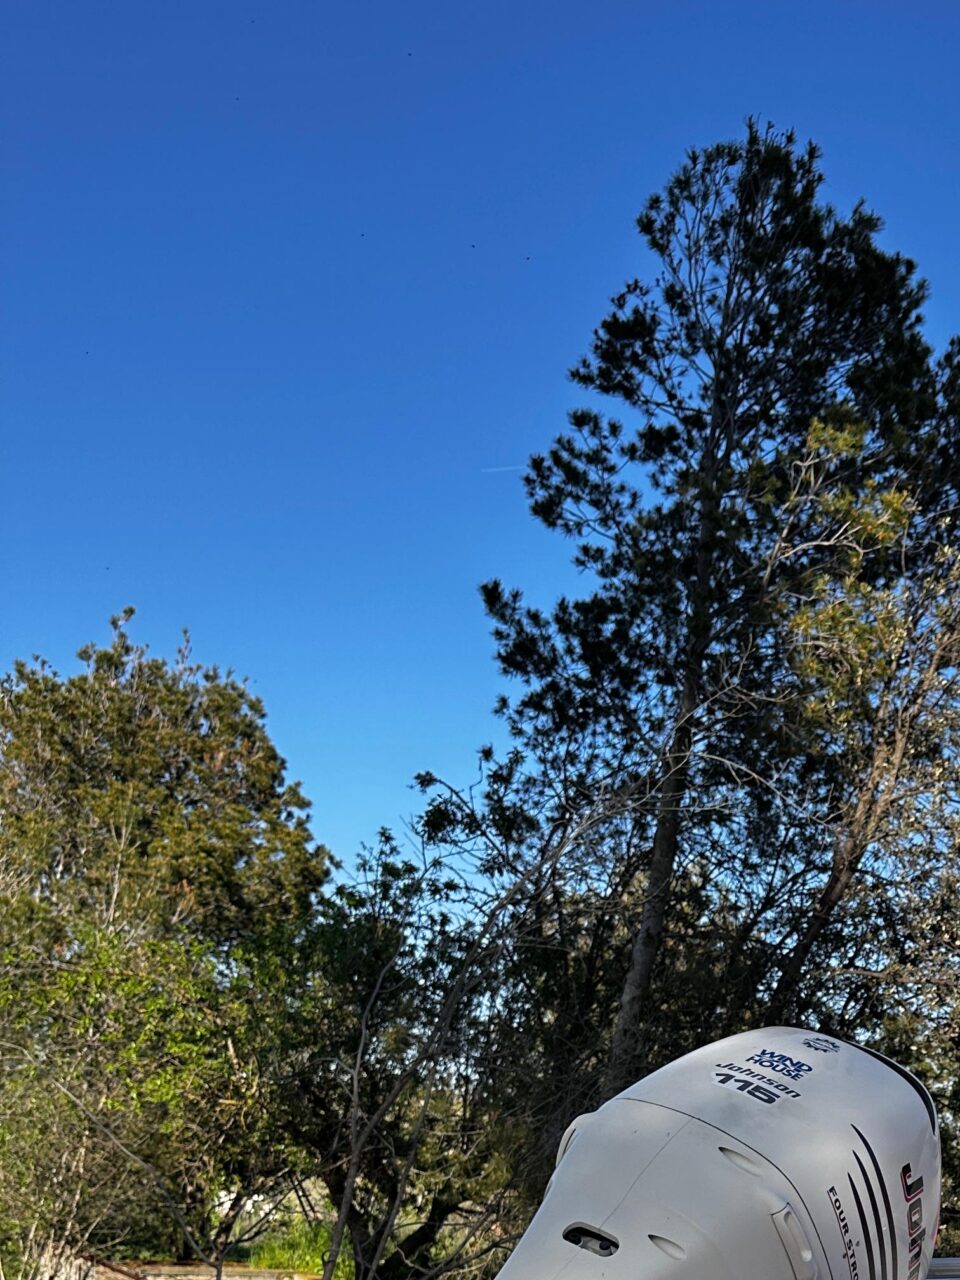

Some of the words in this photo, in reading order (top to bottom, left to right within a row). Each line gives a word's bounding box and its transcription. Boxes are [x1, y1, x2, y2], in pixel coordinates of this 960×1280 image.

[745, 1054, 804, 1081] HOUSE
[760, 1049, 813, 1073] WIND
[715, 1063, 801, 1099] Johnson
[715, 1072, 780, 1104] 115
[828, 1186, 849, 1236] FOUR
